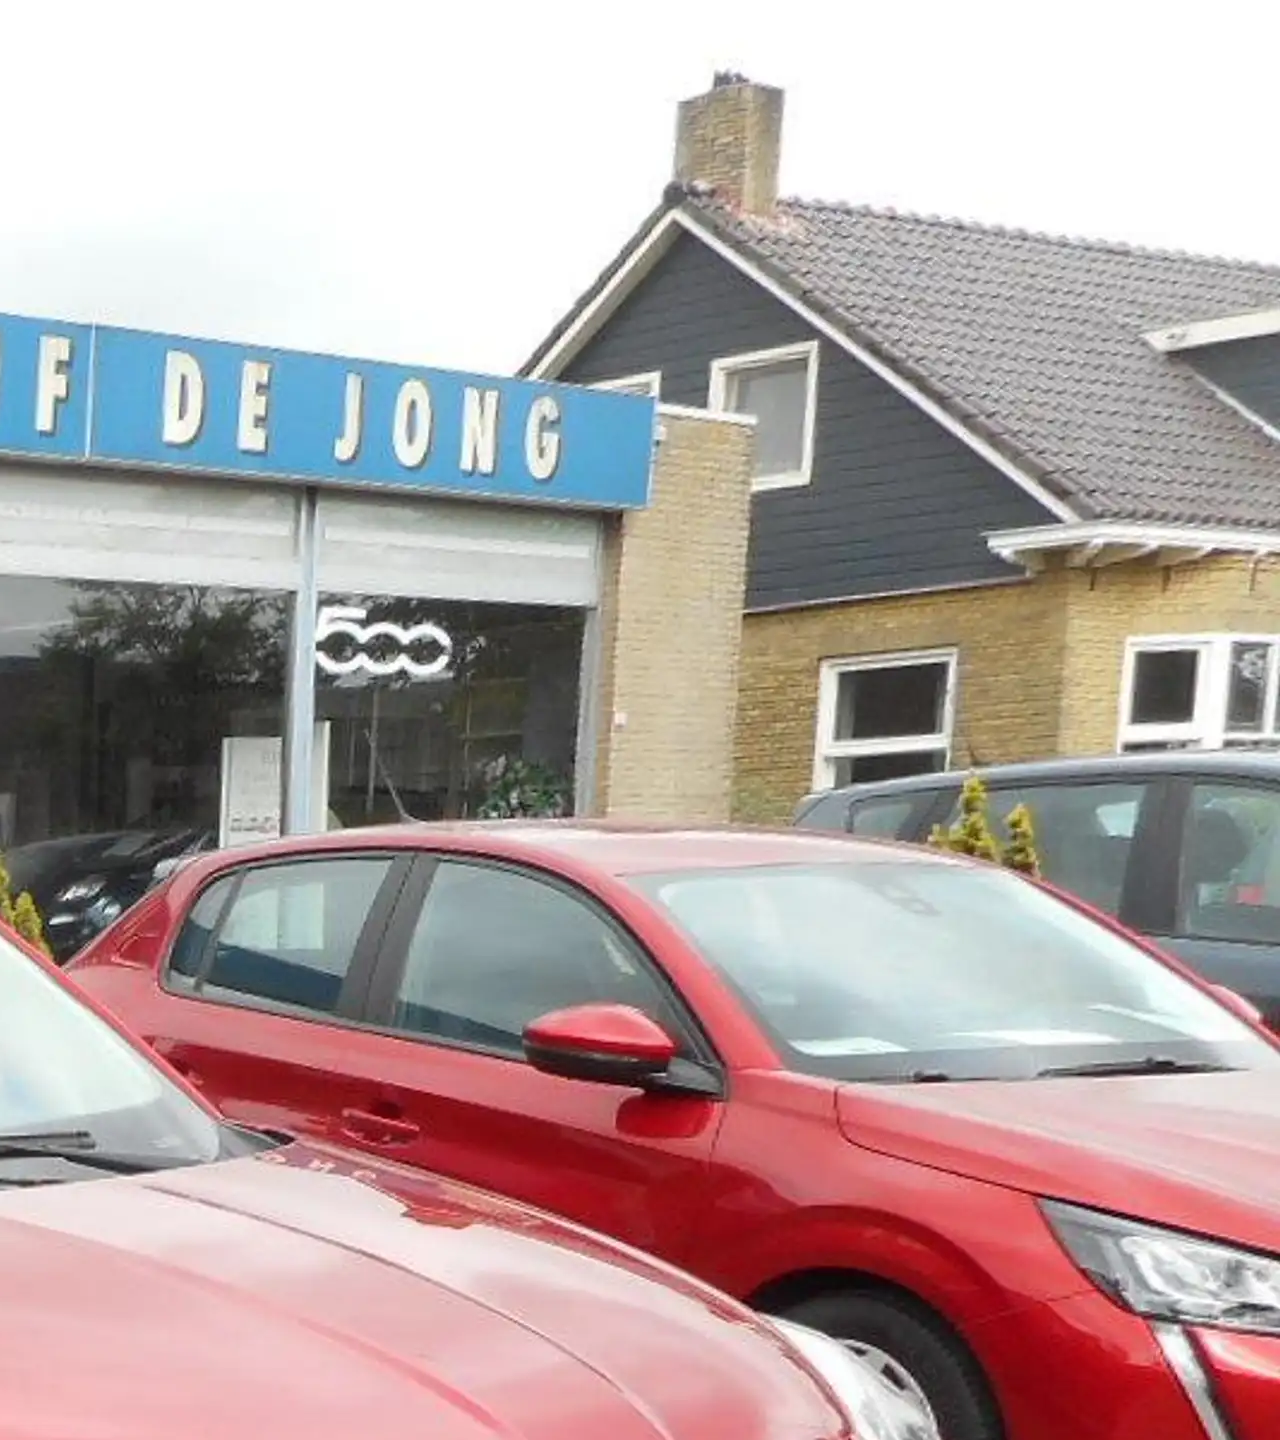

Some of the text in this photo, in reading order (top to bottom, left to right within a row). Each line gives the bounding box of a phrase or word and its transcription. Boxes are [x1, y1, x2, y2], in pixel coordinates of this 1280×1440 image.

[162, 349, 273, 453] DE
[333, 371, 564, 480] JONG
[314, 605, 453, 675] 500
